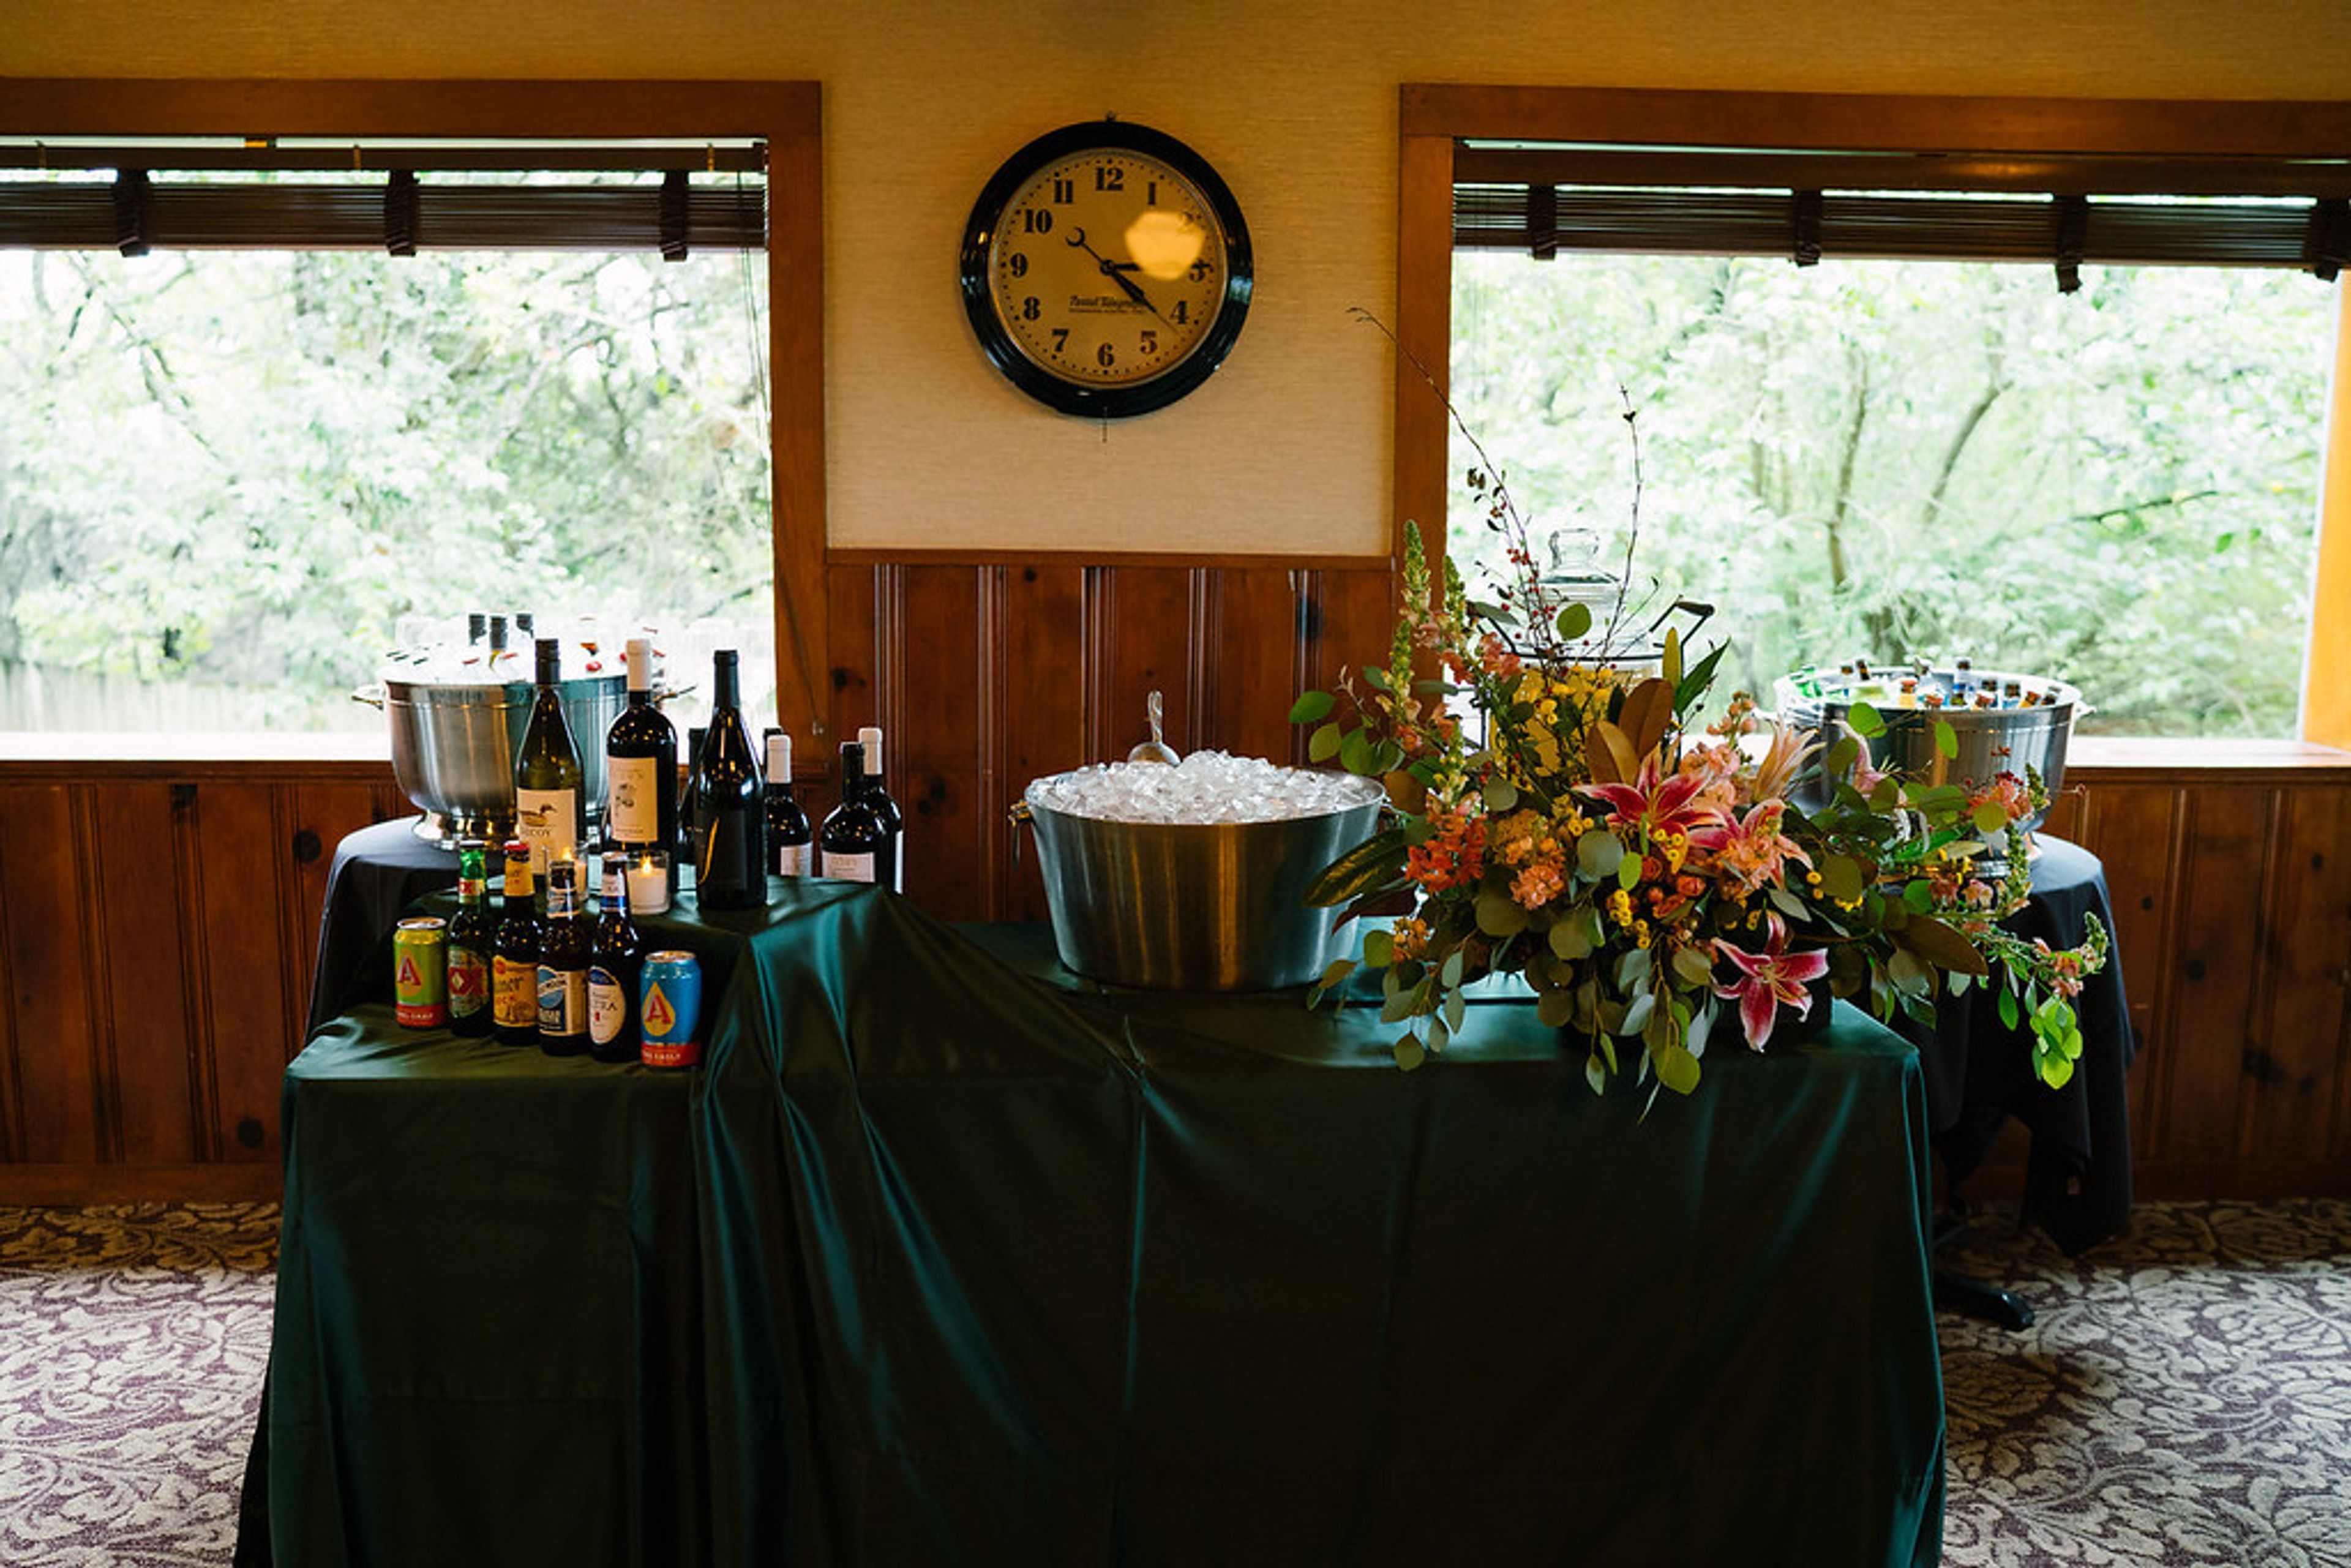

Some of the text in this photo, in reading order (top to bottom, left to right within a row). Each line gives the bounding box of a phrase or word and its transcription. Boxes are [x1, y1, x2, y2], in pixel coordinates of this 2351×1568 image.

[1095, 167, 1123, 191] 12
[1054, 180, 1073, 204] 11
[1147, 182, 1157, 206] 1
[1024, 209, 1052, 234] 10
[1010, 253, 1028, 277] 9
[1024, 296, 1041, 321] 8
[1169, 301, 1190, 324] 4
[1052, 329, 1069, 352] 7
[1139, 331, 1157, 354] 5
[1097, 342, 1115, 367] 6
[398, 956, 421, 985] A
[645, 994, 671, 1024] A
